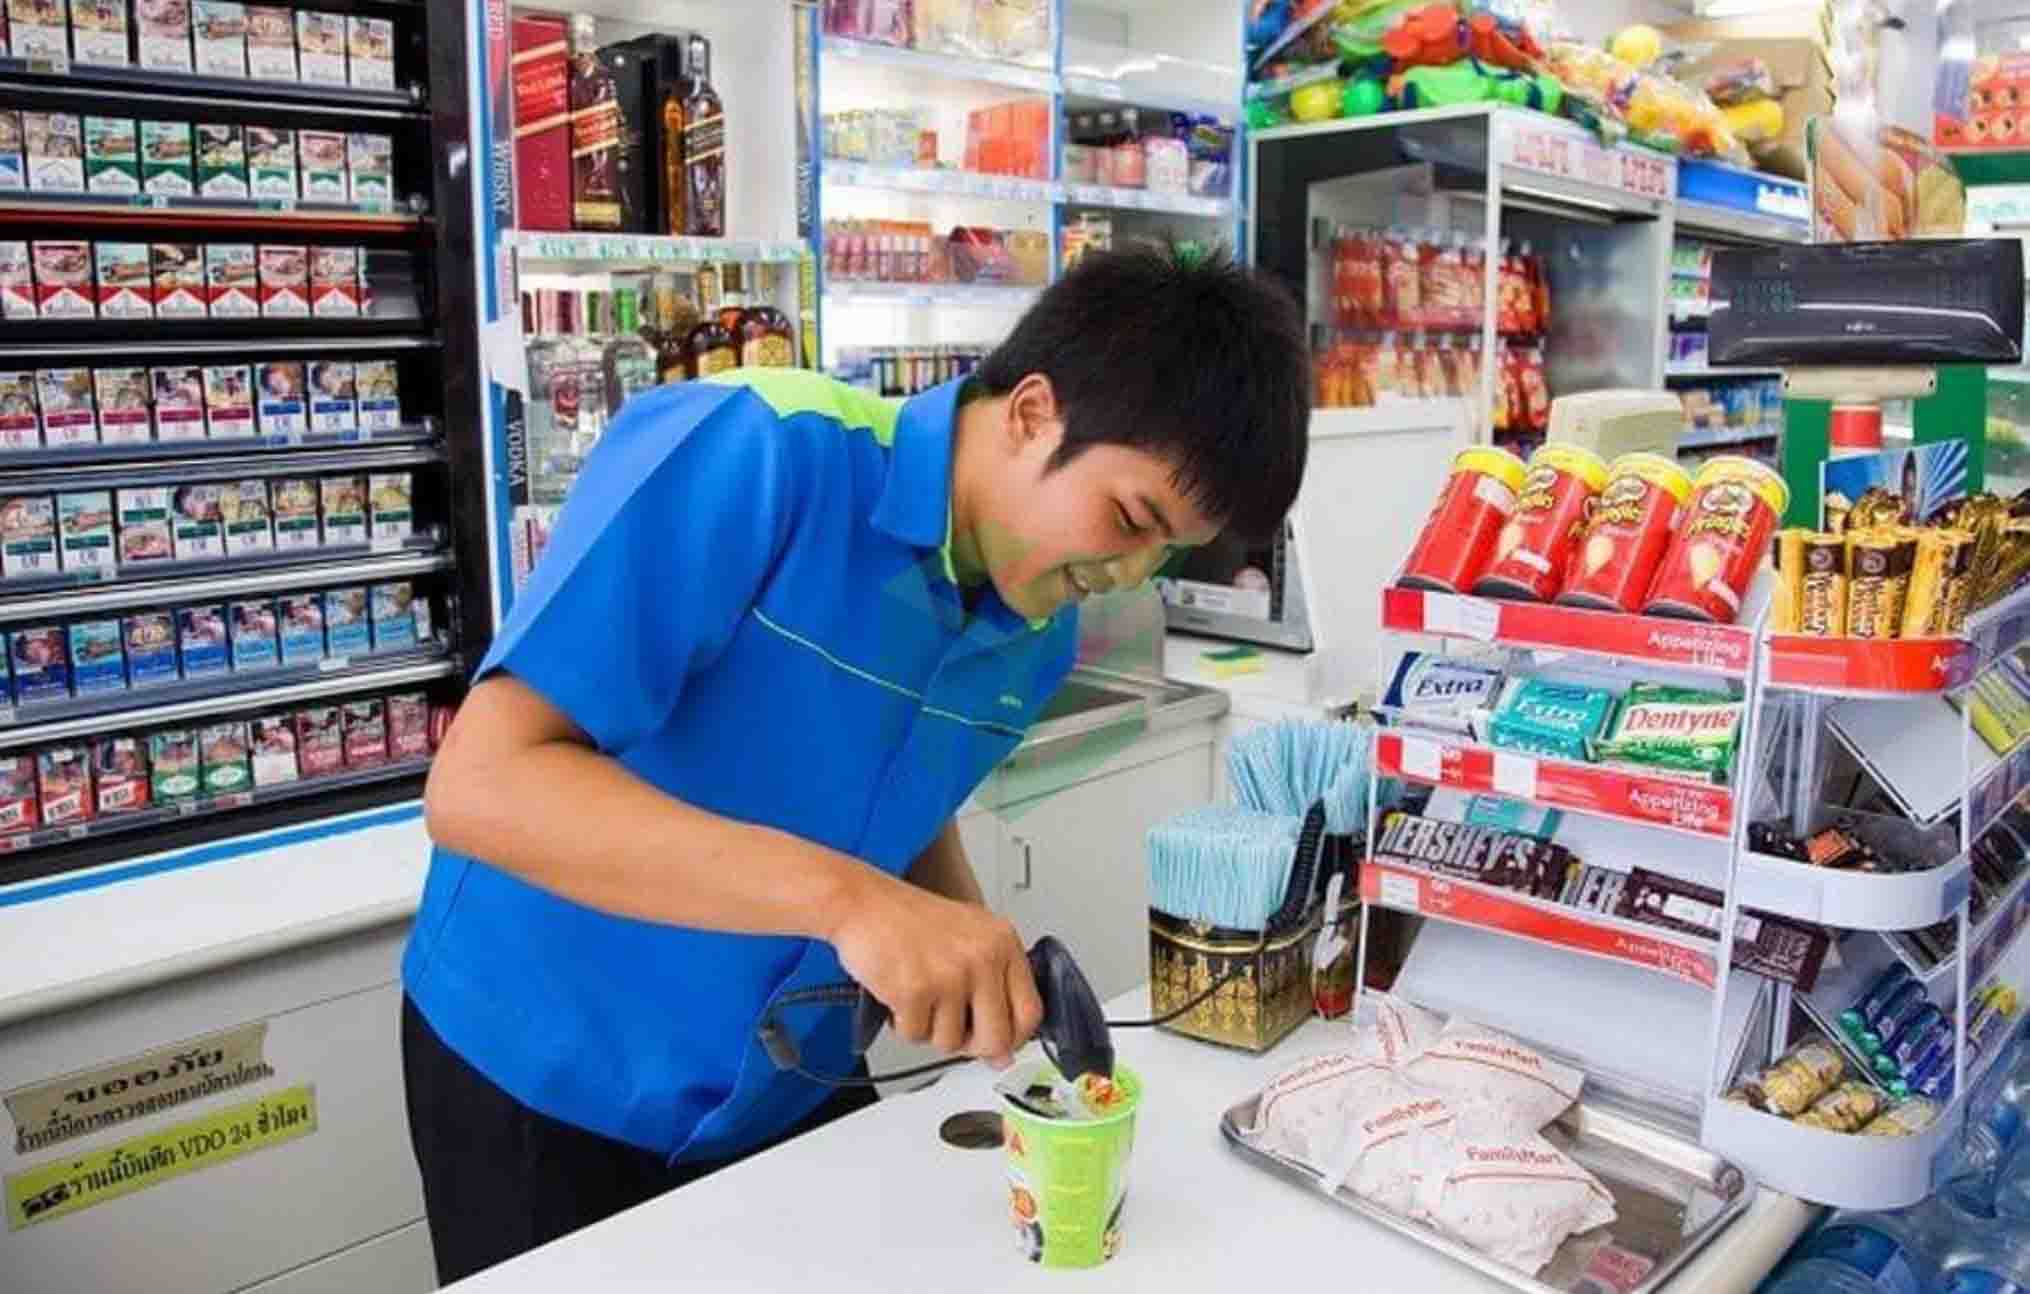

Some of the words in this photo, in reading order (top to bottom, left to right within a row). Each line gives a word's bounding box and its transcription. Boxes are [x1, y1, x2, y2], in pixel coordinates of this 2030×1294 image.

[1416, 677, 1484, 698] Extra
[1626, 706, 1735, 733] Dentyne
[180, 1130, 227, 1158] VDO
[229, 1124, 253, 1147] 24
[1466, 1144, 1563, 1165] FamilyMart
